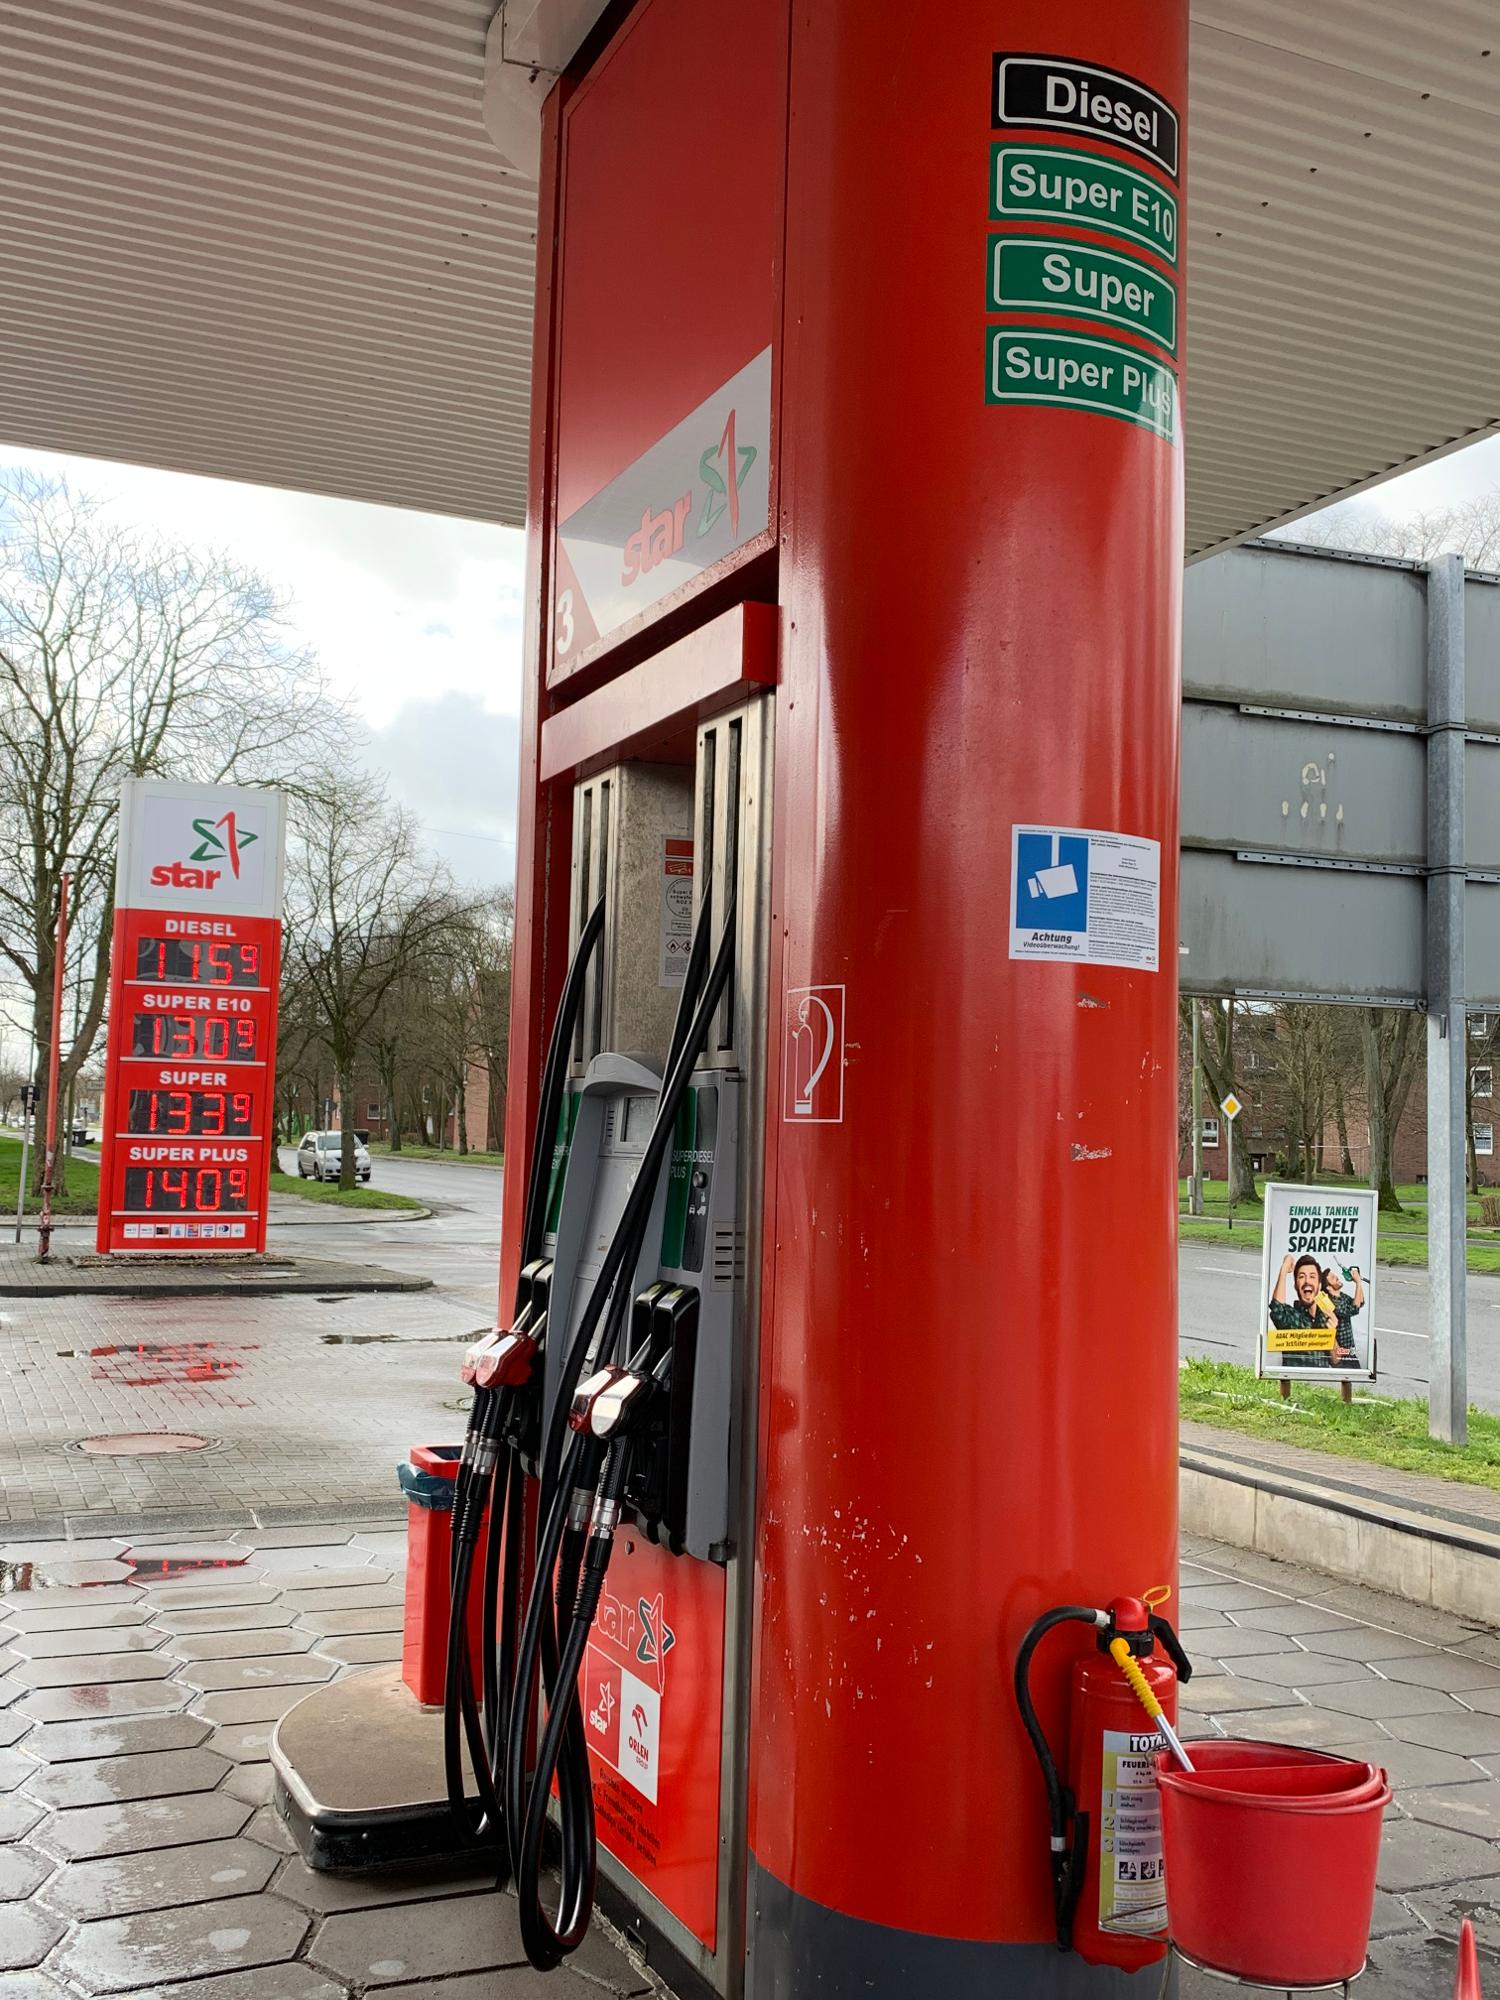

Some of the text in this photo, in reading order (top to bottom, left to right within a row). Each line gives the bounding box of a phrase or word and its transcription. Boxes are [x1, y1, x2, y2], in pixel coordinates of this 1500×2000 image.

[1046, 75, 1159, 147] Diesel
[1009, 163, 1174, 242] Super E10
[1042, 254, 1155, 317] Super
[1005, 347, 1171, 416] Super Plus
[621, 490, 692, 587] star
[556, 588, 574, 655] 3
[150, 861, 221, 890] star
[165, 919, 236, 937] DIESEL
[1023, 941, 1080, 951] Videoüberwachung!
[1031, 932, 1072, 944] Achtung
[142, 994, 251, 1012] SUPER E10
[159, 1071, 227, 1086] SUPER
[129, 1147, 248, 1162] SUPER PLUS
[1289, 1206, 1359, 1216] EINMAL TANKEN
[1288, 1218, 1358, 1234] DOPPELT
[1288, 1236, 1355, 1253] SPAREN!
[591, 1580, 635, 1651] tar
[590, 1710, 607, 1735] star
[628, 1735, 649, 1762] ORLEN
[1131, 1734, 1167, 1752] TOTA
[1129, 1861, 1155, 1870] A B
